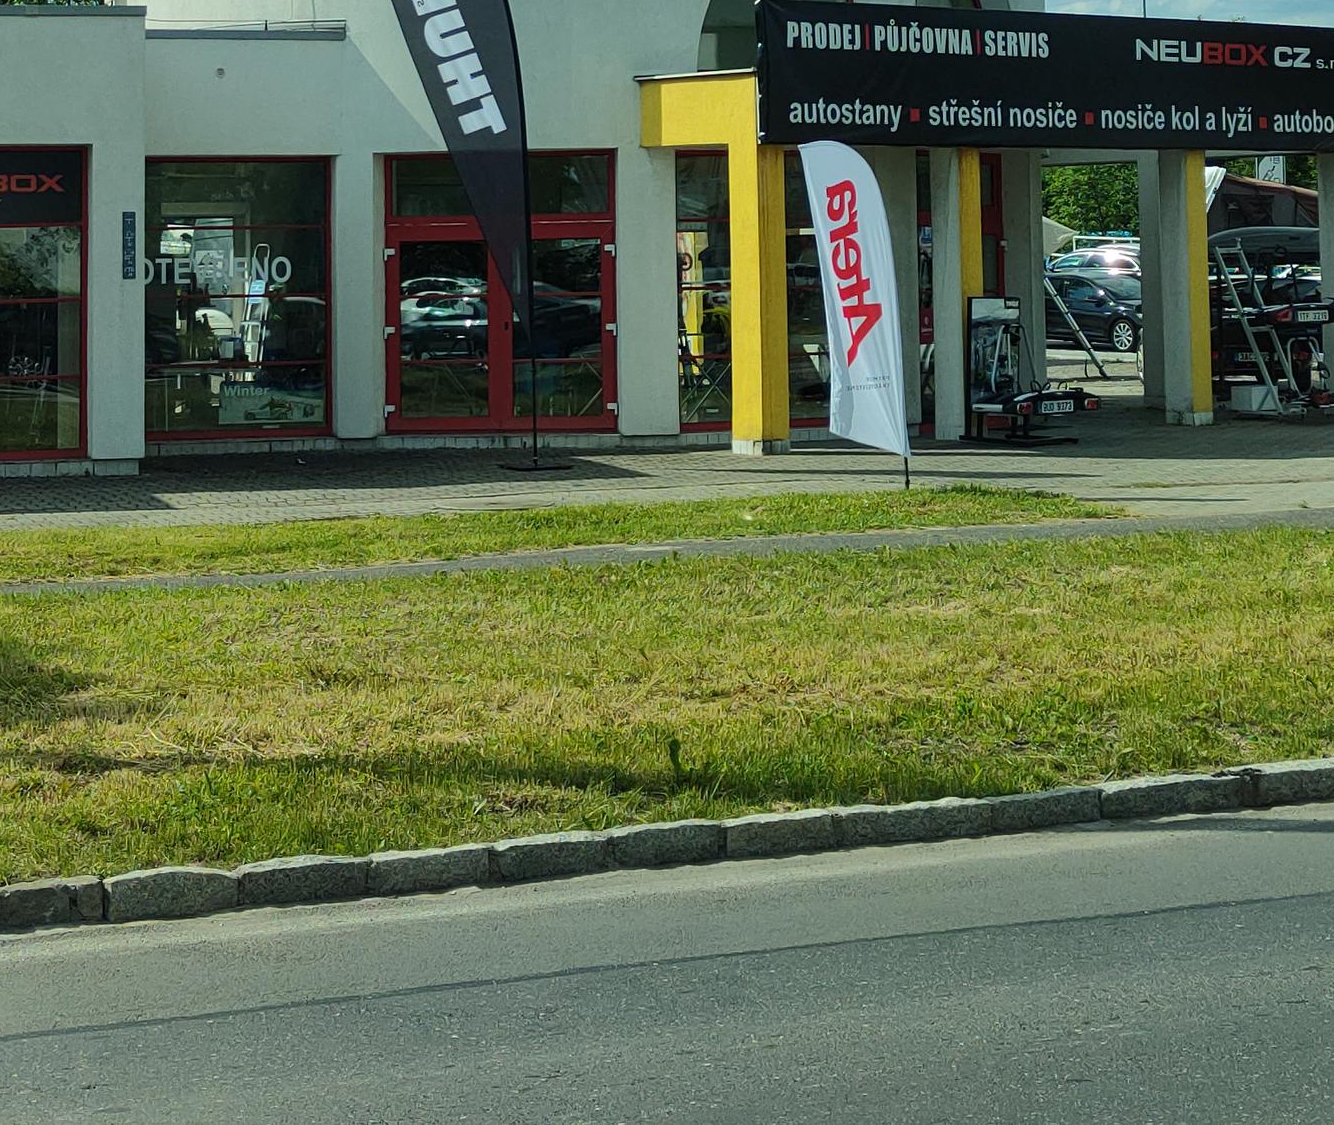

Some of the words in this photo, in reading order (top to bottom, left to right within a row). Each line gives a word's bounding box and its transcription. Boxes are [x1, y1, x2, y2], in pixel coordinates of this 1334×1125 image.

[786, 21, 861, 51] PRODEJ
[874, 19, 973, 55] PŮJČOVNA
[984, 29, 1049, 58] SERVIS
[1135, 38, 1268, 66] NEUBOX
[1273, 46, 1312, 68] CZ
[789, 97, 902, 132] autostany
[928, 98, 1003, 127] střešní
[1009, 101, 1077, 129] nosiče
[1101, 104, 1165, 130] nosiče
[1171, 105, 1199, 131] kol
[1205, 111, 1216, 131] a
[1222, 106, 1253, 138] lyží
[224, 384, 270, 396] Winter
